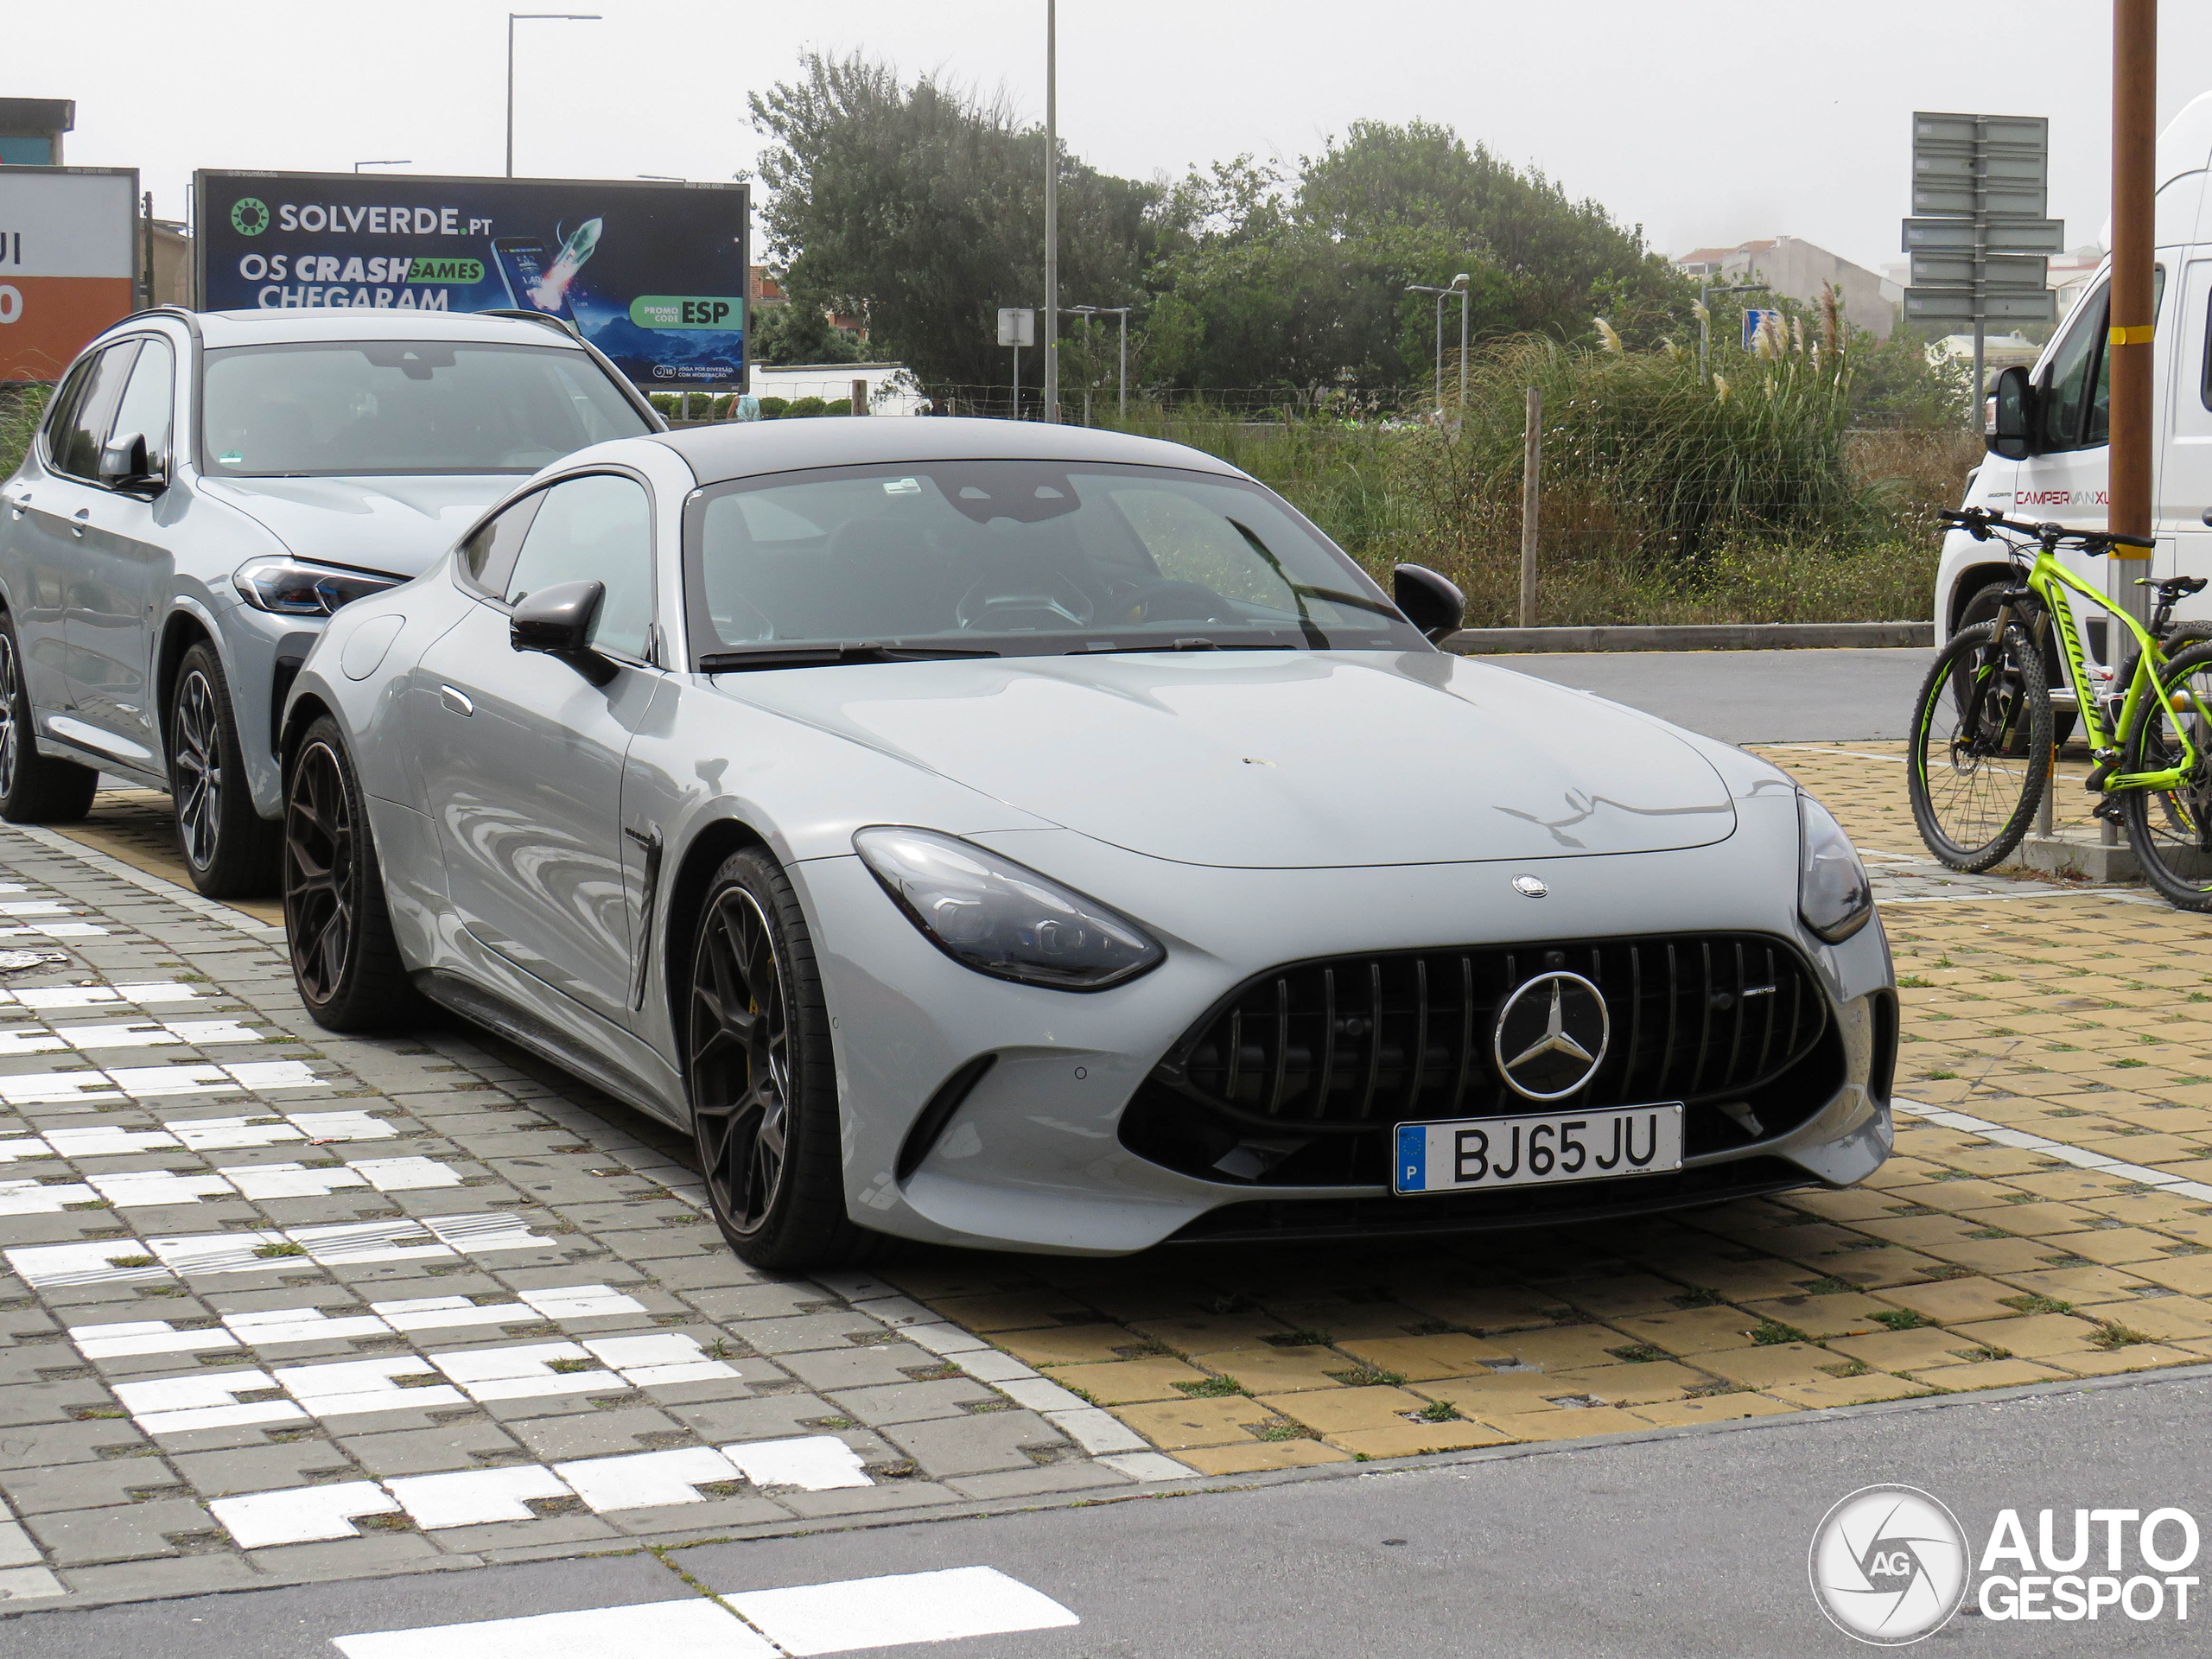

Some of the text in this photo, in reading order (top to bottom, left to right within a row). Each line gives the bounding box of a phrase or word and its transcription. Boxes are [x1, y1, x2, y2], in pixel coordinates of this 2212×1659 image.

[239, 254, 288, 281] OS
[682, 302, 730, 324] ESP
[1407, 1166, 1418, 1180] P
